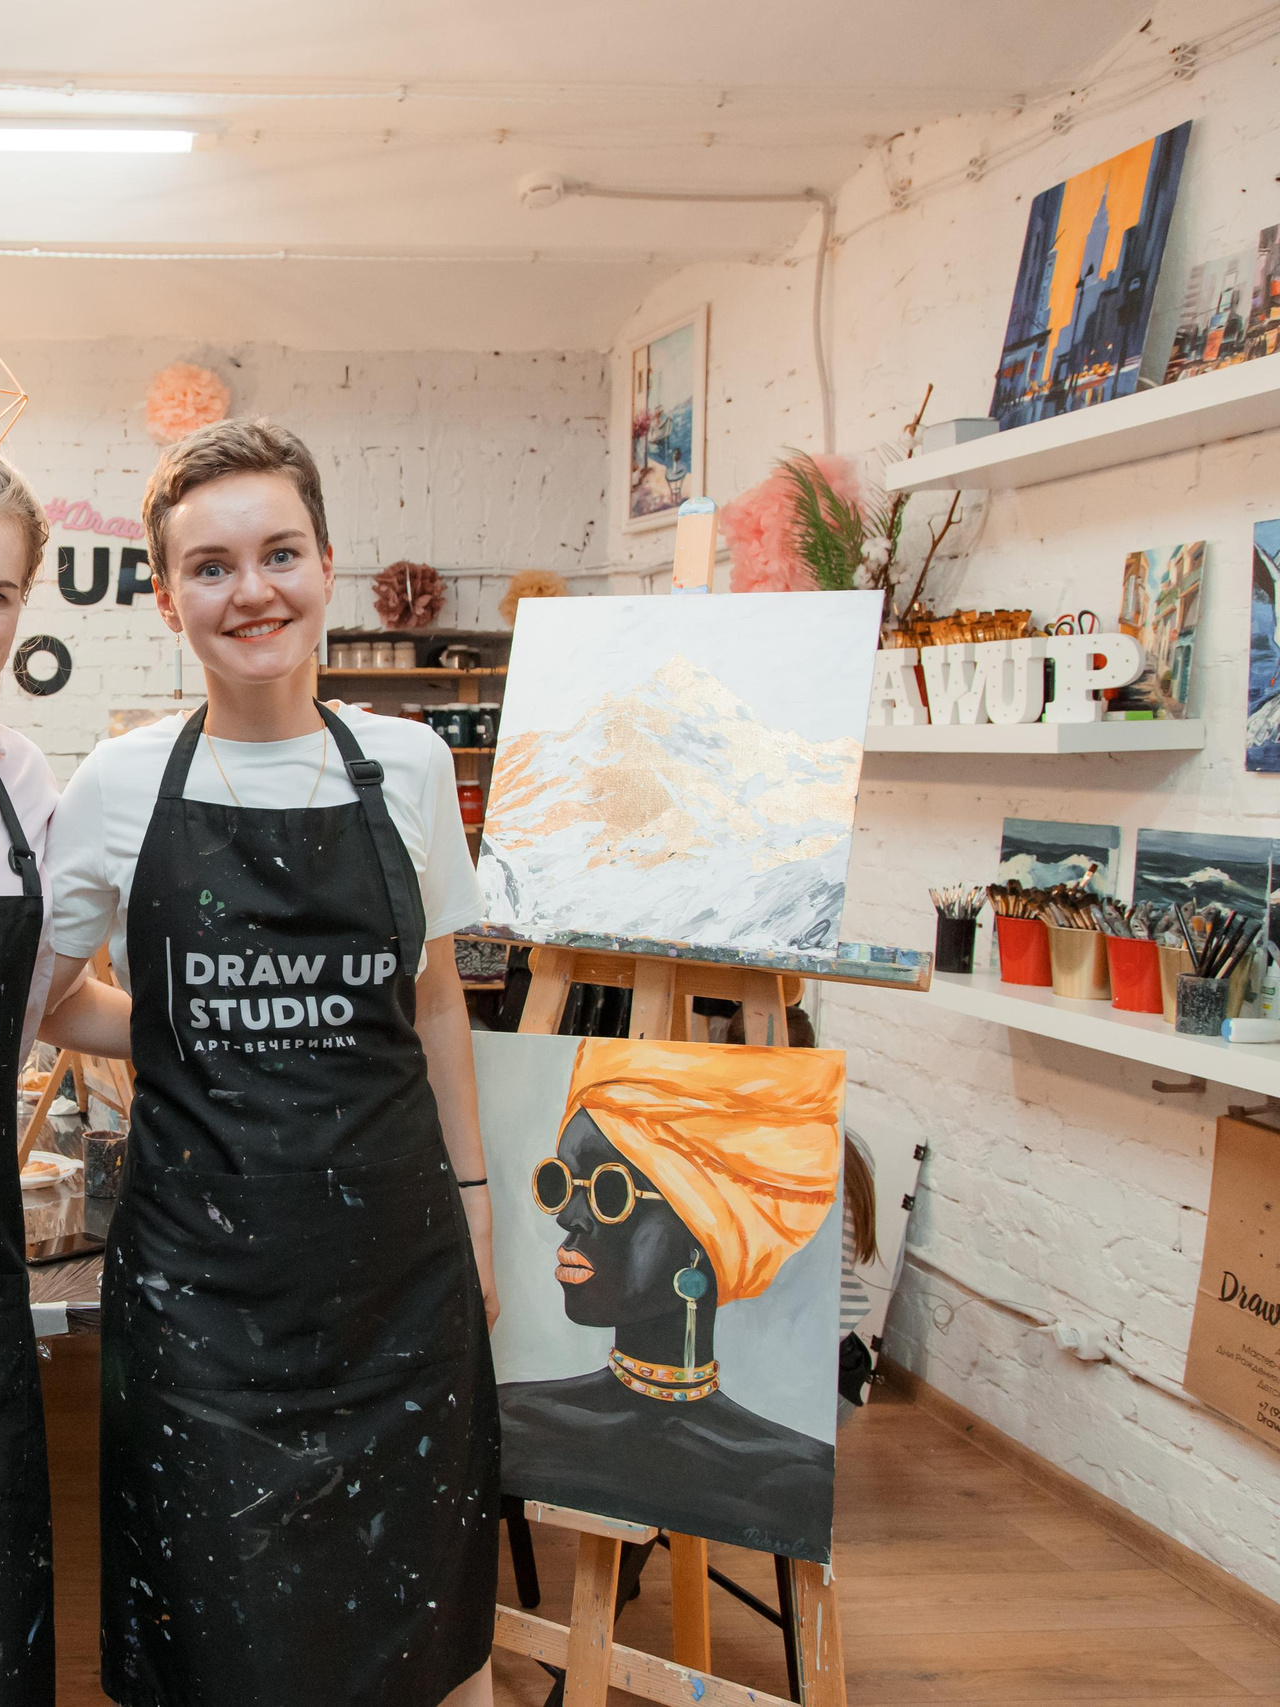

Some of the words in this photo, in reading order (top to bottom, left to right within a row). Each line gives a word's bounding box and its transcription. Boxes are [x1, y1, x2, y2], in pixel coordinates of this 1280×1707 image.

[57, 546, 155, 606] UP
[185, 952, 327, 987] DRAW
[341, 952, 398, 987] UP
[189, 994, 354, 1031] STUDIO
[193, 1035, 358, 1054] АРТ-ВЕЧЕРИНКИ
